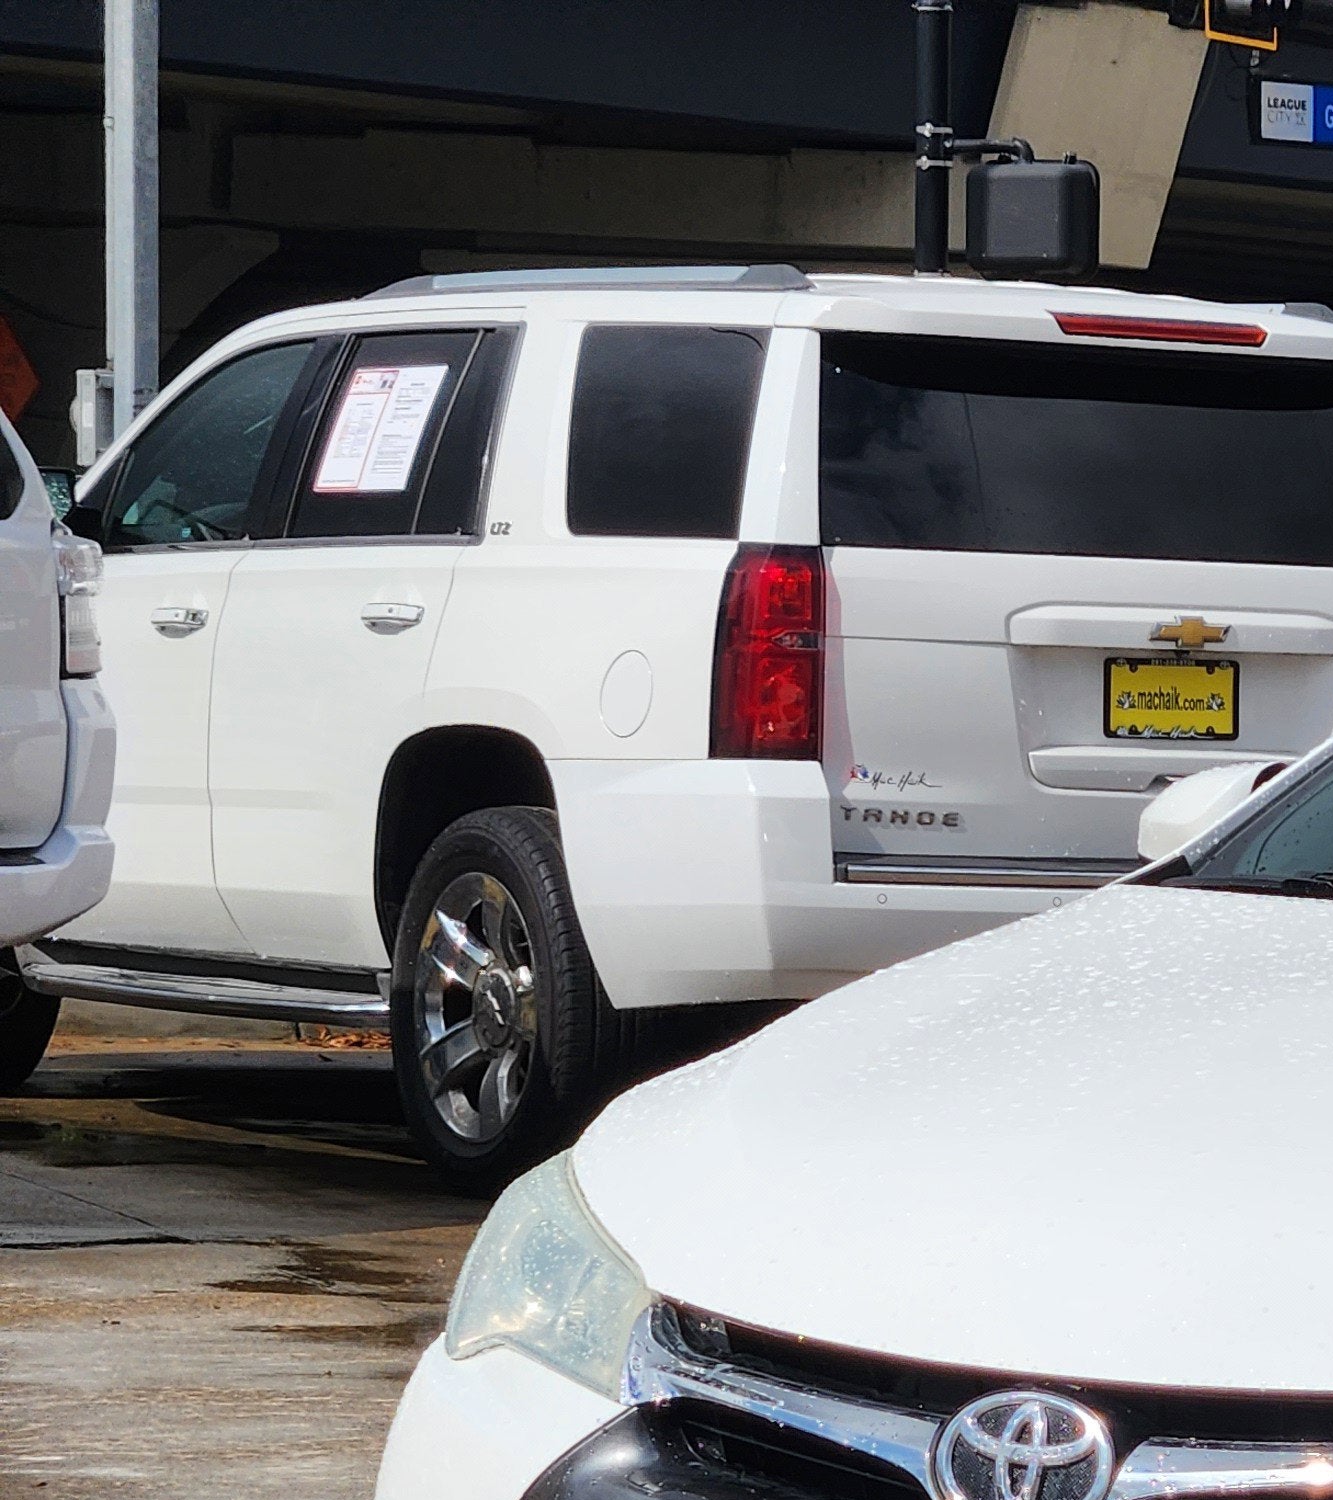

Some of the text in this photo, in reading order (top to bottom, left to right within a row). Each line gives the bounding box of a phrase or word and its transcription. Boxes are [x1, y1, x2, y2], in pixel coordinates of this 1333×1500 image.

[1266, 96, 1307, 111] LEAGUE
[1267, 110, 1291, 124] CITY
[1137, 686, 1205, 711] machaik.com
[840, 804, 960, 827] TAHOE
